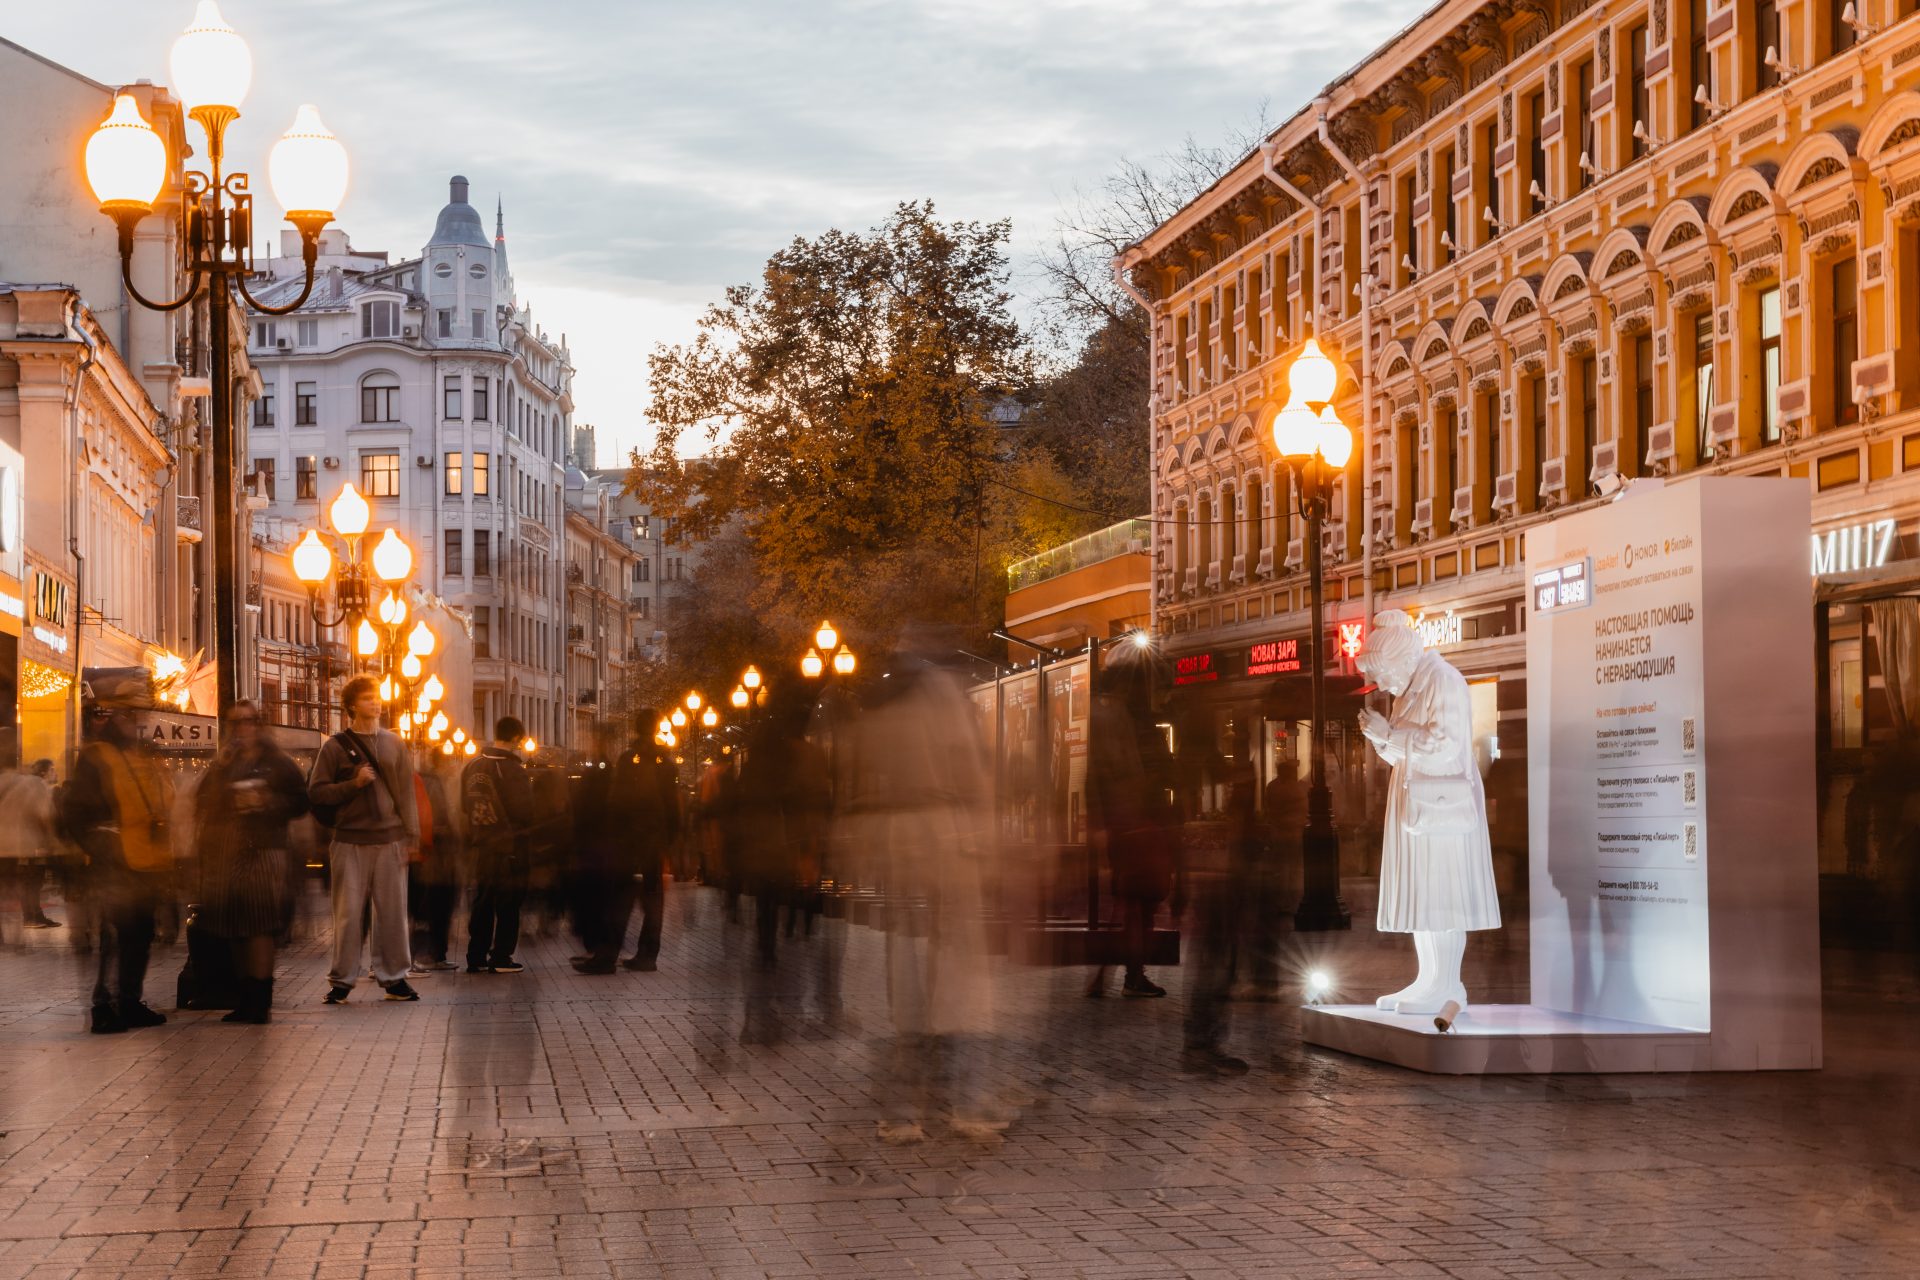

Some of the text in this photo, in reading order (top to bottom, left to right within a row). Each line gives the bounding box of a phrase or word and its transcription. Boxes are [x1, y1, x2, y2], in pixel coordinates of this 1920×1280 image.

[1634, 543, 1658, 561] HONOR
[1670, 535, 1693, 552] билайн
[1679, 565, 1694, 576] связи
[1595, 602, 1694, 638] НАСТОЯЩАЯ ПОМОЩЬ
[1251, 640, 1297, 663] НОВАЯ ЗАРЯ
[1595, 634, 1652, 661] НАЧИНАЕТСЯ
[1595, 655, 1676, 685] С НЕРАВНОДУШИЯ
[136, 725, 212, 740] TAKSI
